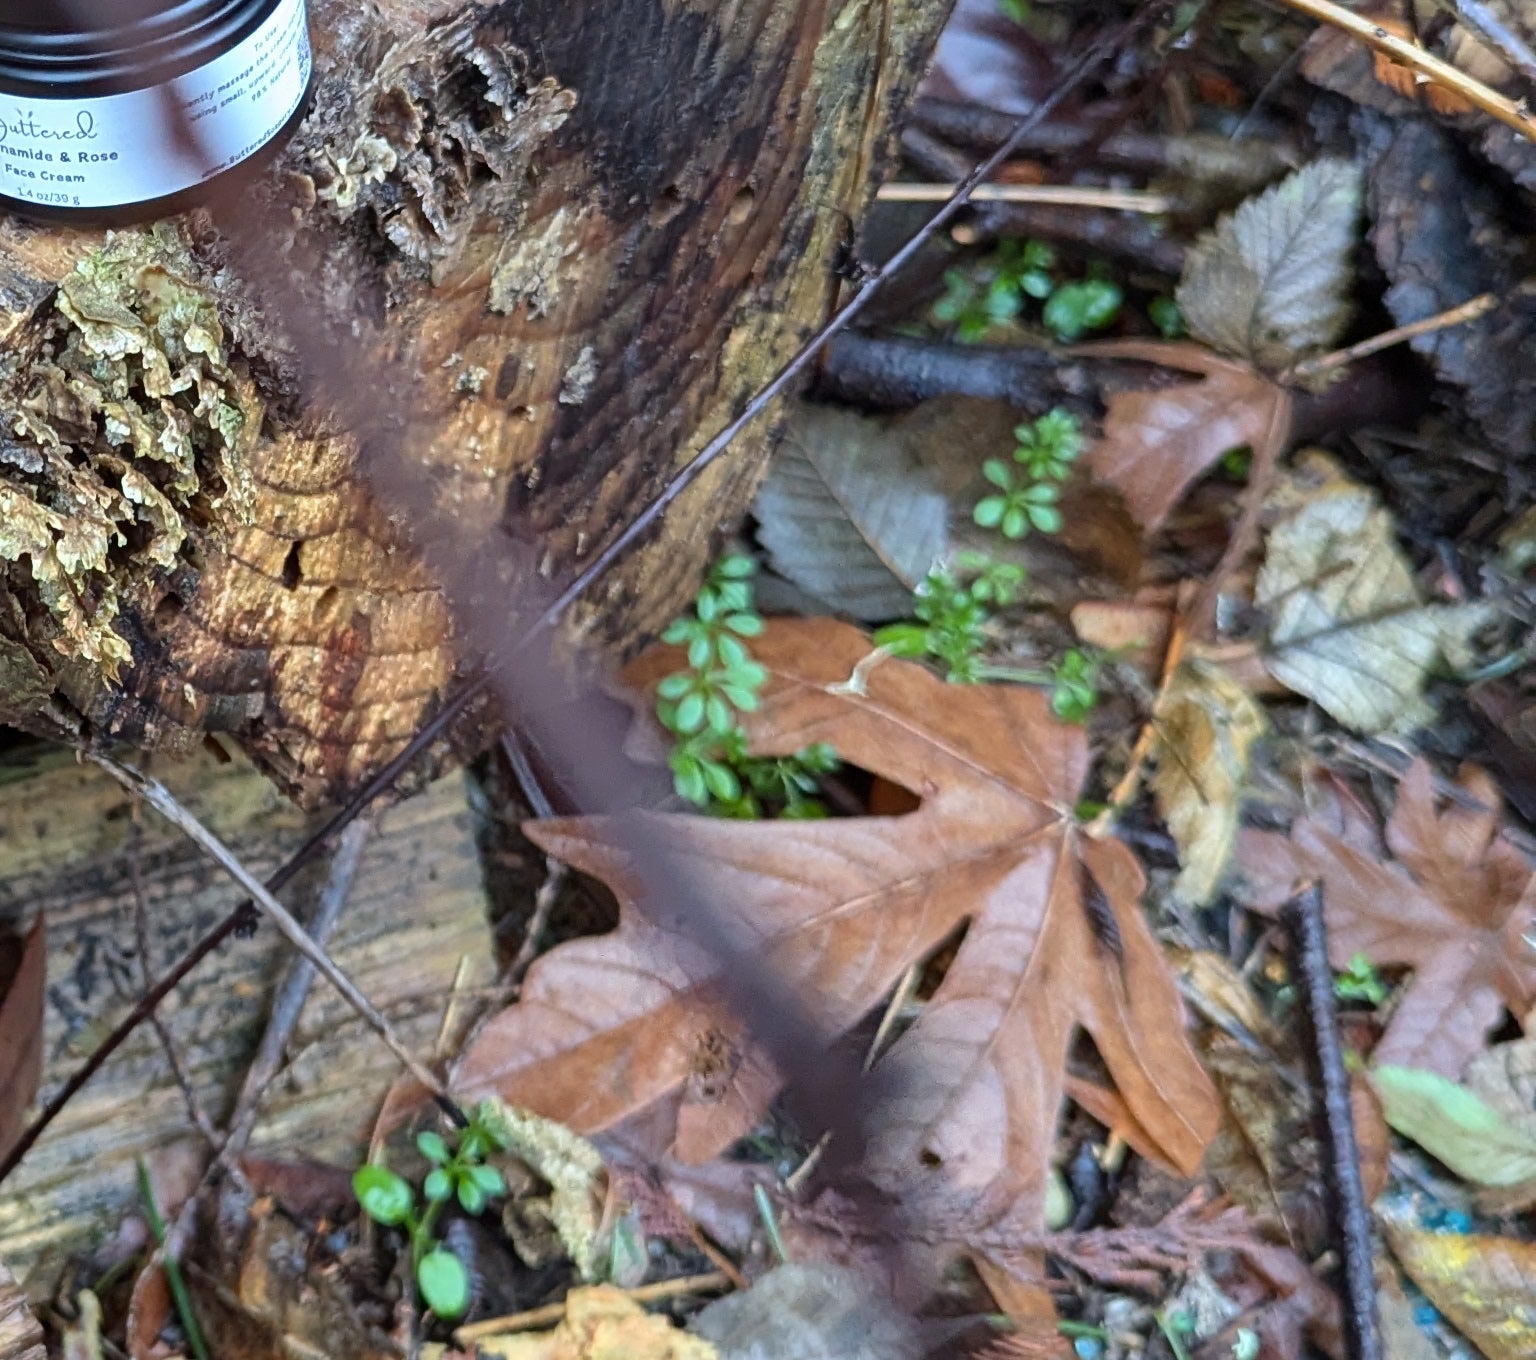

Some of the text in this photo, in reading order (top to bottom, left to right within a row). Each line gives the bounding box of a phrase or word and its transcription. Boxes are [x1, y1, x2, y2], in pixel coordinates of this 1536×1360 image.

[184, 90, 215, 109] ently
[218, 65, 254, 93] massage
[60, 151, 71, 163] &
[78, 151, 119, 163] Rose
[5, 163, 85, 183] Face Cream
[17, 187, 34, 199] 1.4
[73, 196, 81, 206] g
